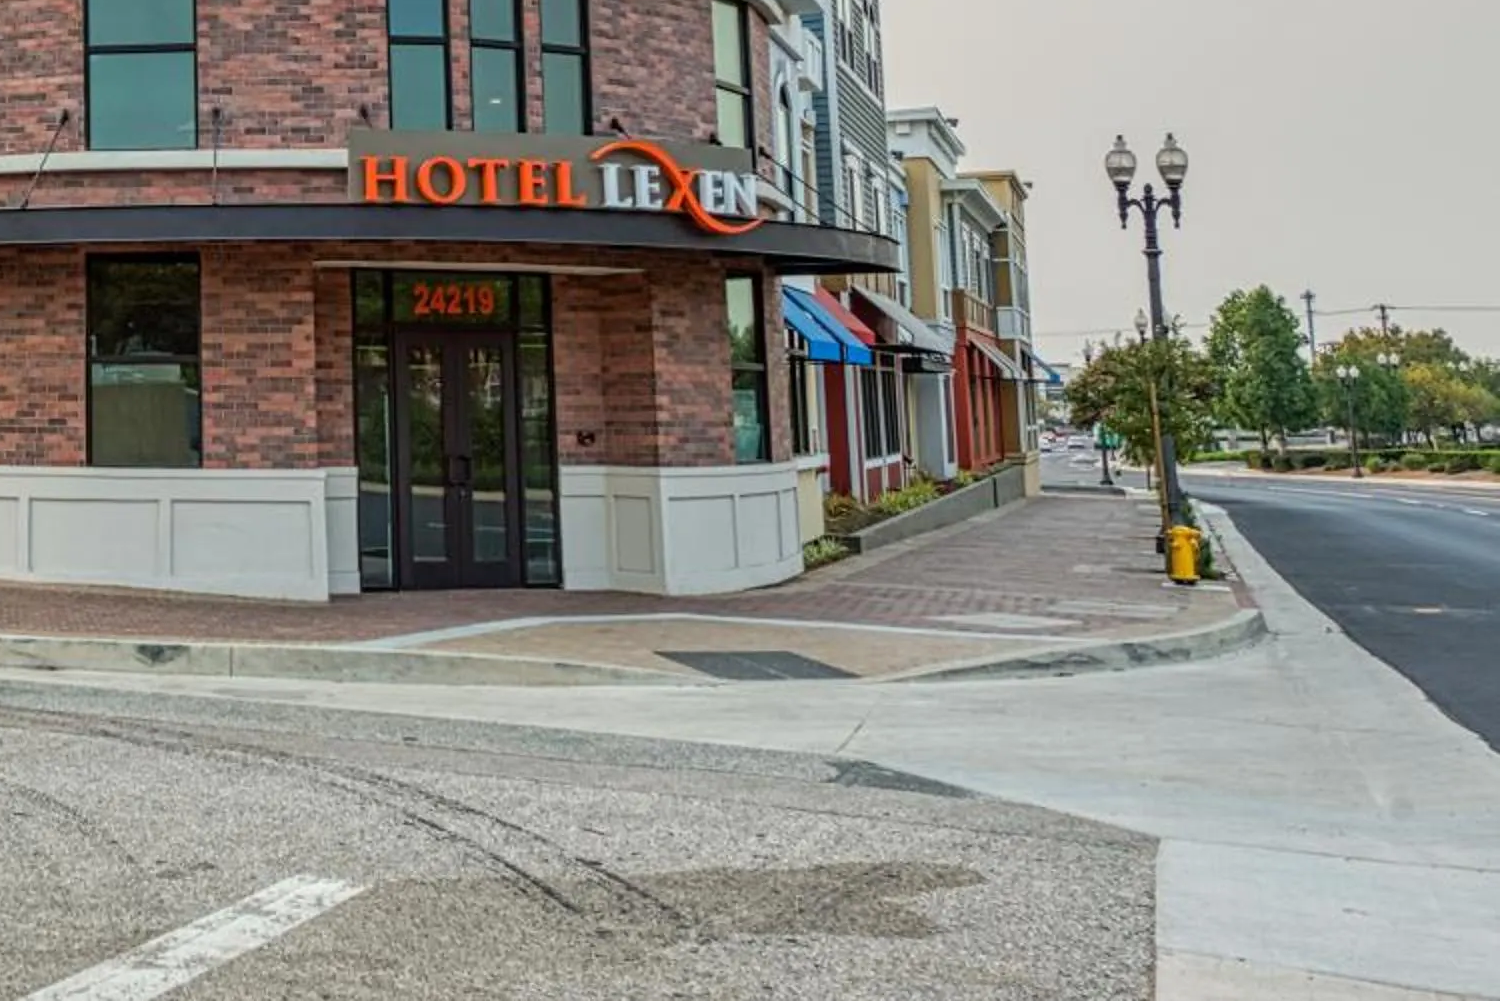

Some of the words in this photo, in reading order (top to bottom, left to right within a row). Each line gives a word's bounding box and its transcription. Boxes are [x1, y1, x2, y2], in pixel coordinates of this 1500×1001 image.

[360, 155, 587, 206] HOTEL
[591, 142, 764, 233] LEXEN
[413, 284, 494, 315] 24219
